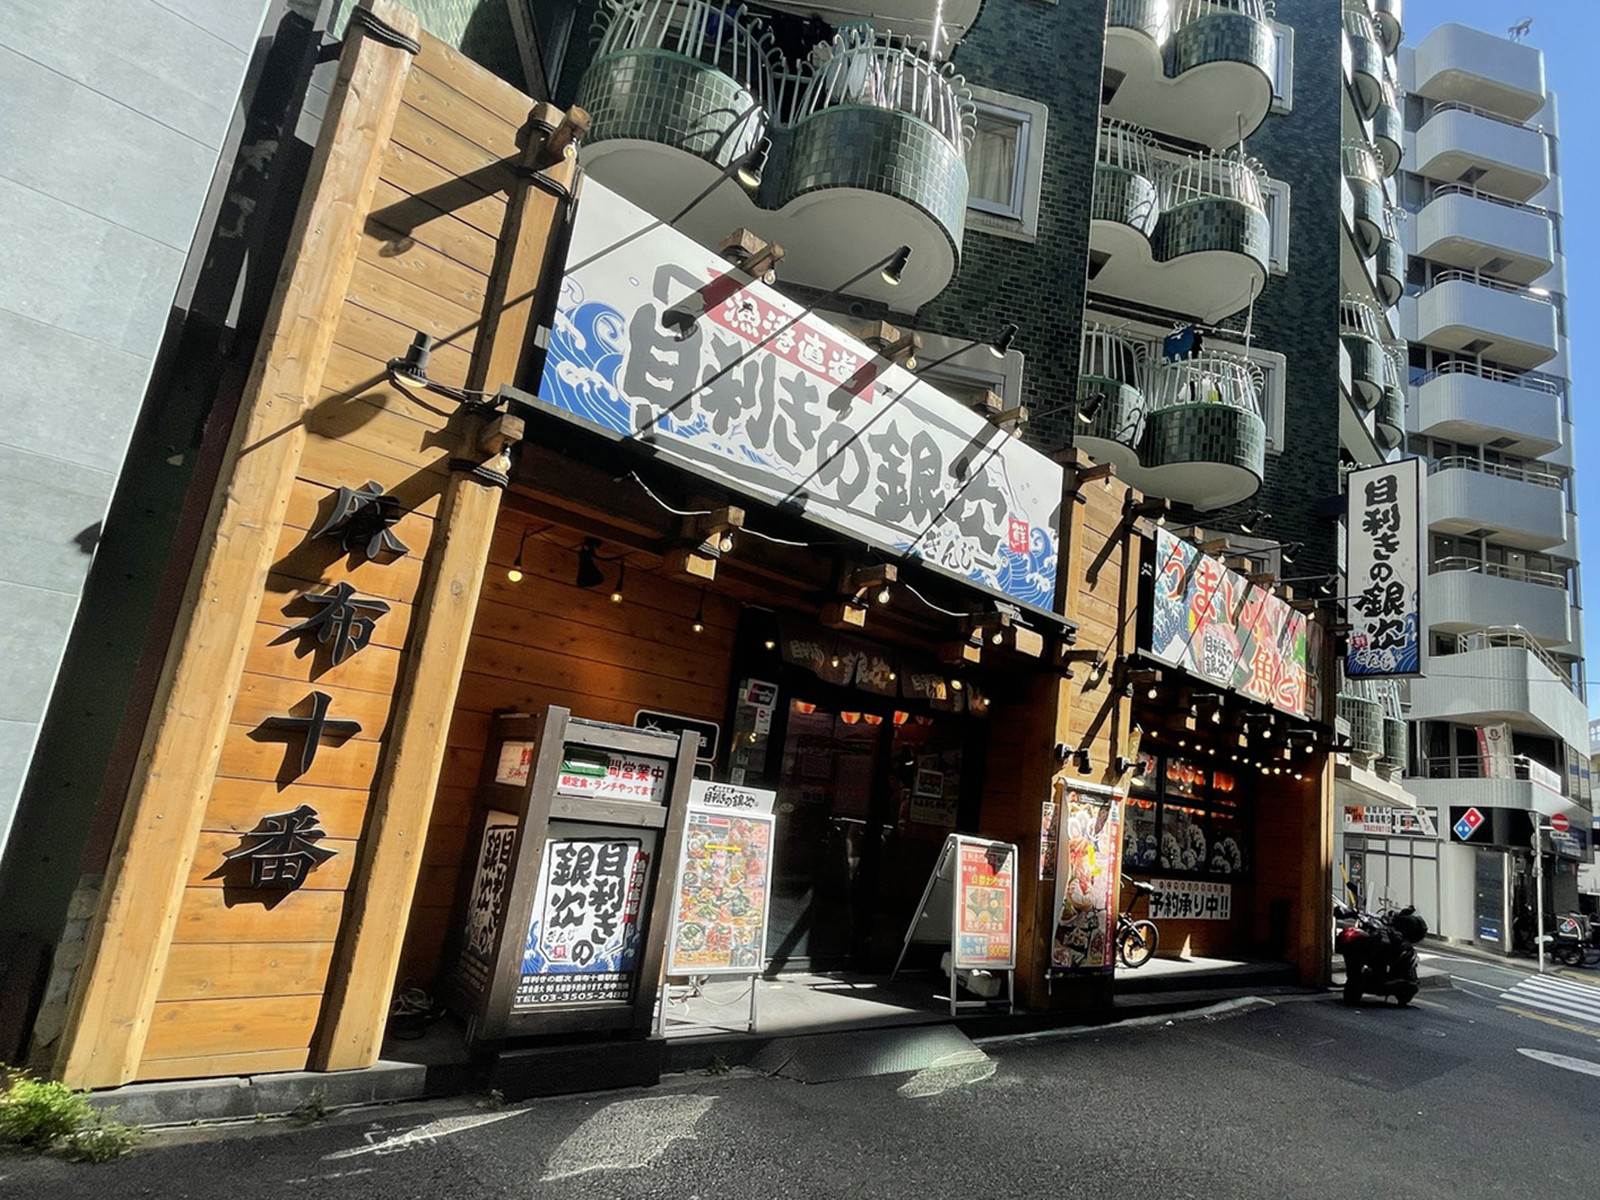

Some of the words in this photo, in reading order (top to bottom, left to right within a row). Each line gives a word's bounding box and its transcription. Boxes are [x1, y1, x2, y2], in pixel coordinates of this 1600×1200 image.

[628, 304, 1007, 556] 目利きの銀次
[1164, 541, 1260, 628] うまい
[1353, 474, 1407, 650] 目利きの銀次
[227, 480, 411, 889] 麻布十番
[550, 842, 595, 930] 銀次
[572, 843, 628, 965] 目利きの
[1150, 891, 1229, 918] 予約承り中!!
[515, 995, 540, 1003] TEL
[540, 991, 629, 1003] 03-3505-2488
